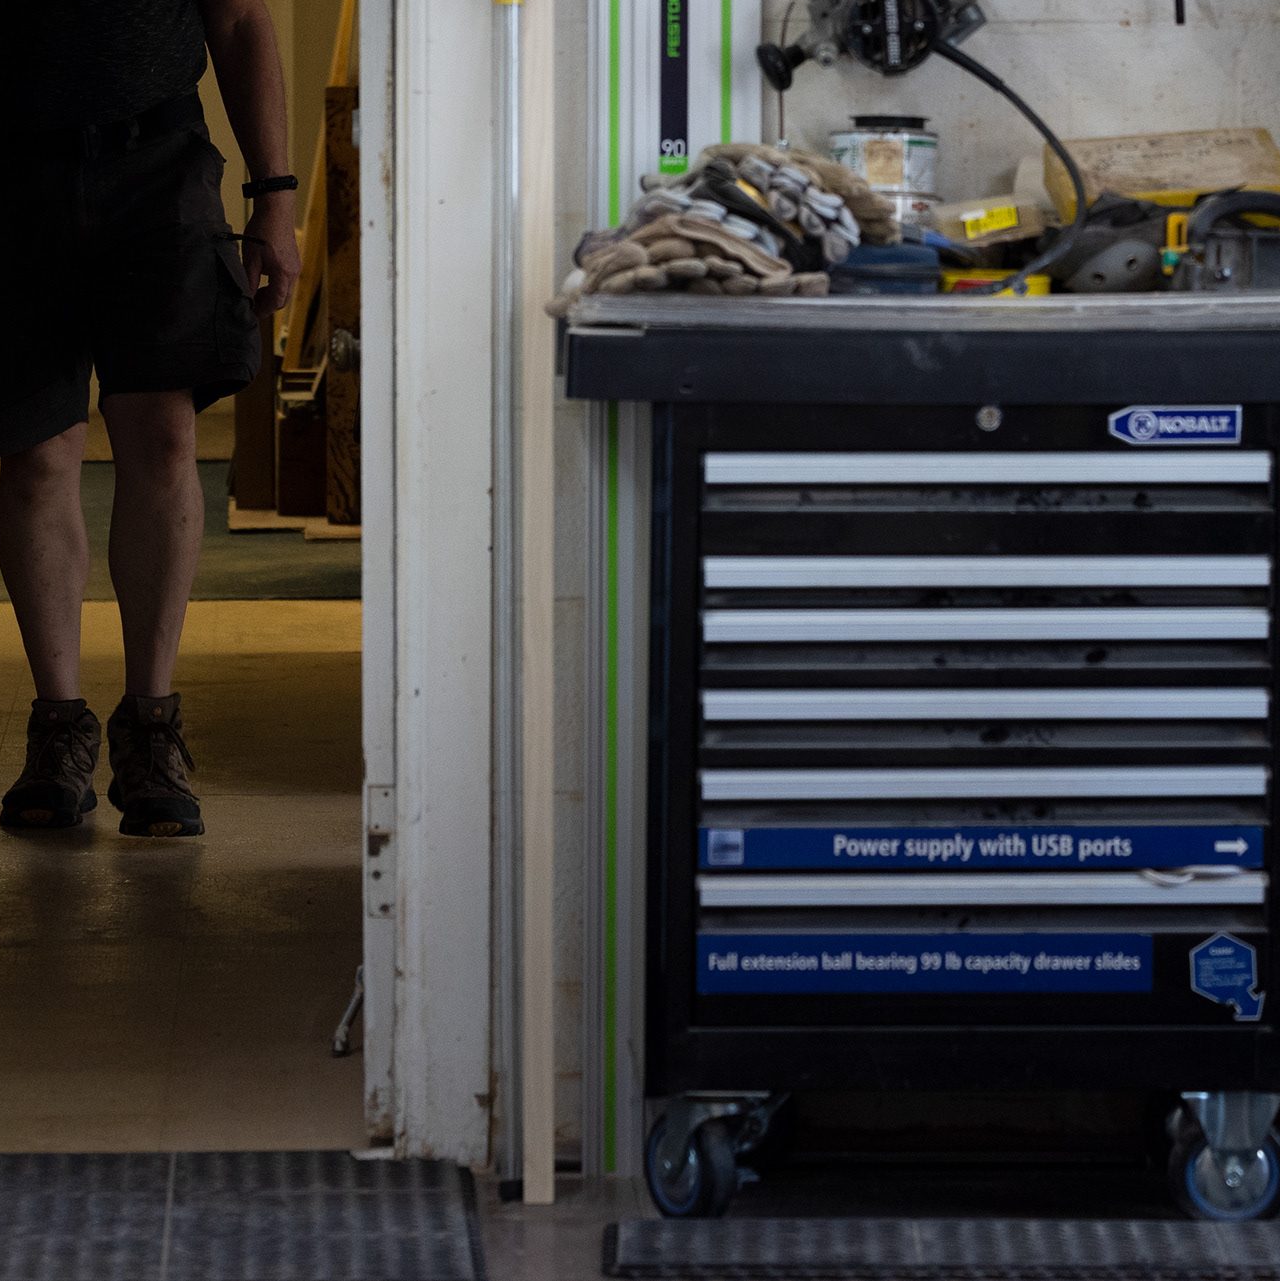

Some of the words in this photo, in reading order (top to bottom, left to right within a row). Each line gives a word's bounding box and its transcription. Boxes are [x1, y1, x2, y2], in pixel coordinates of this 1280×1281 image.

[661, 139, 686, 158] 90
[1158, 416, 1231, 433] KOBALT
[833, 834, 901, 857] Power
[904, 833, 975, 862] supply
[978, 833, 1026, 857] with
[1031, 834, 1073, 857] USB
[1078, 836, 1132, 862] ports
[708, 952, 738, 971] Full
[740, 952, 818, 971] extension
[821, 952, 852, 971] ball
[855, 951, 917, 974] bearing
[920, 952, 942, 971] 99
[945, 951, 962, 971] lb
[964, 951, 1031, 974] capacity
[1033, 951, 1092, 971] drawer
[1094, 951, 1141, 971] slides
